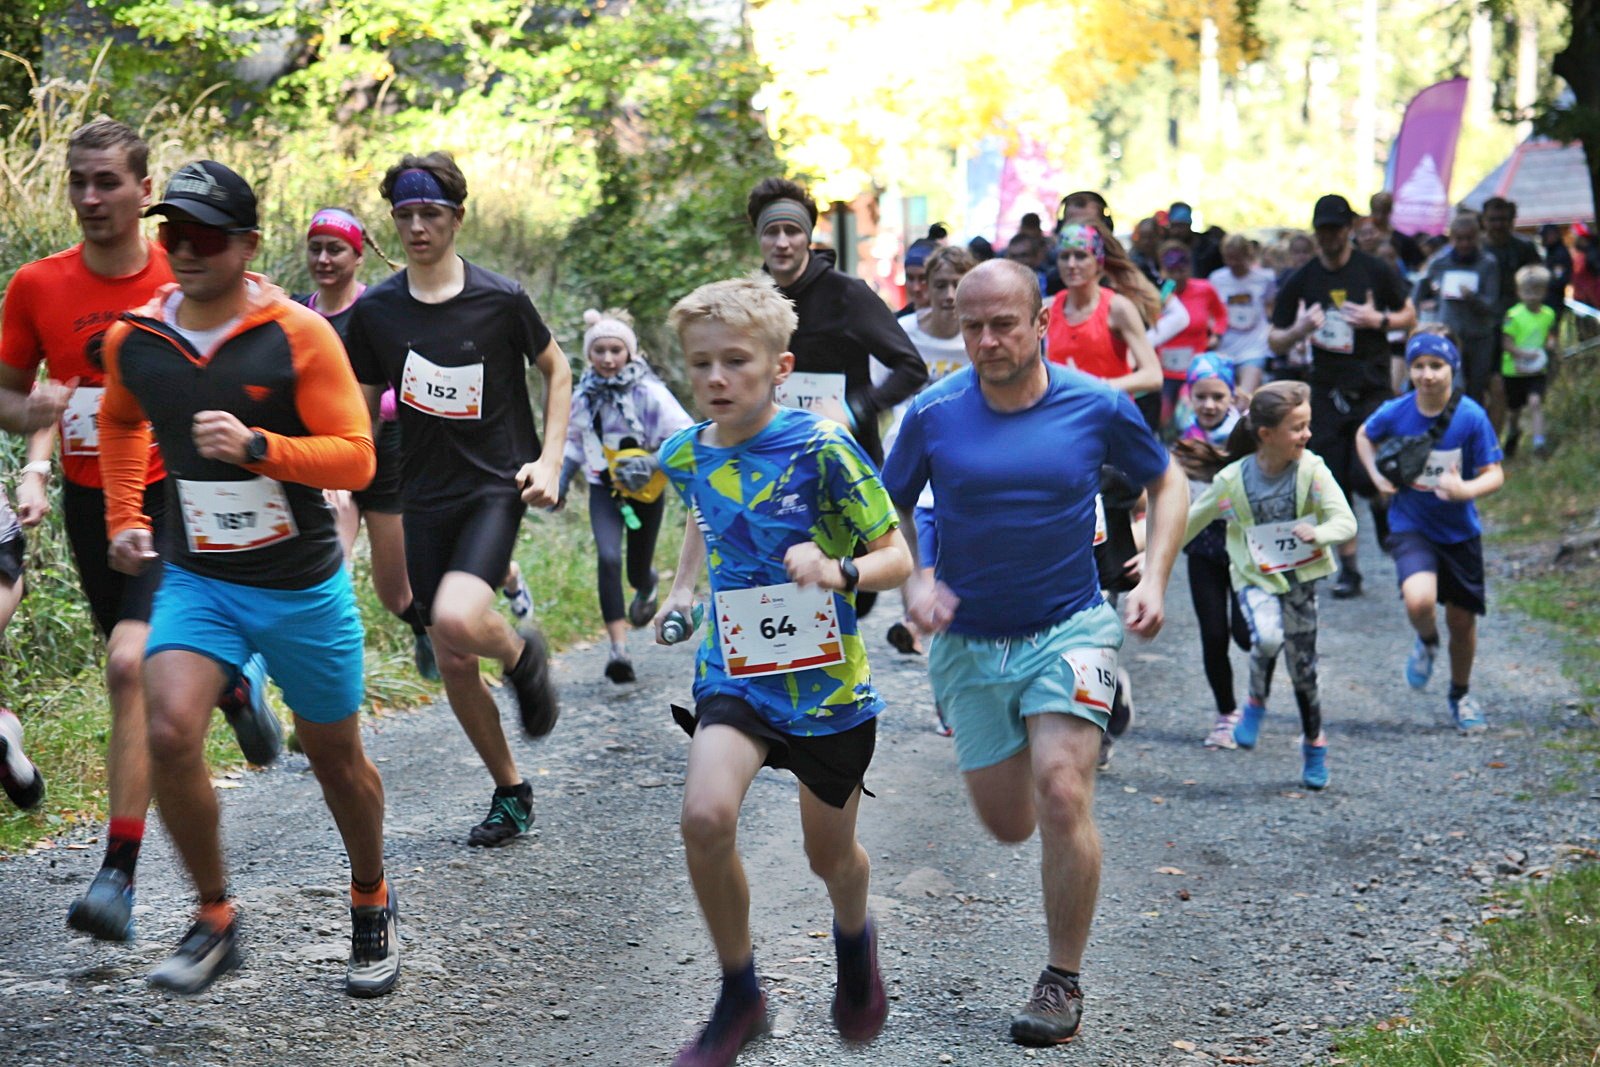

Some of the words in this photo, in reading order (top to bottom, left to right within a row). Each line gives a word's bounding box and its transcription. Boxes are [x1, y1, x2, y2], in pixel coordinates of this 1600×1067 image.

[426, 382, 457, 400] 152
[1275, 538, 1297, 551] 73
[760, 615, 797, 640] 64
